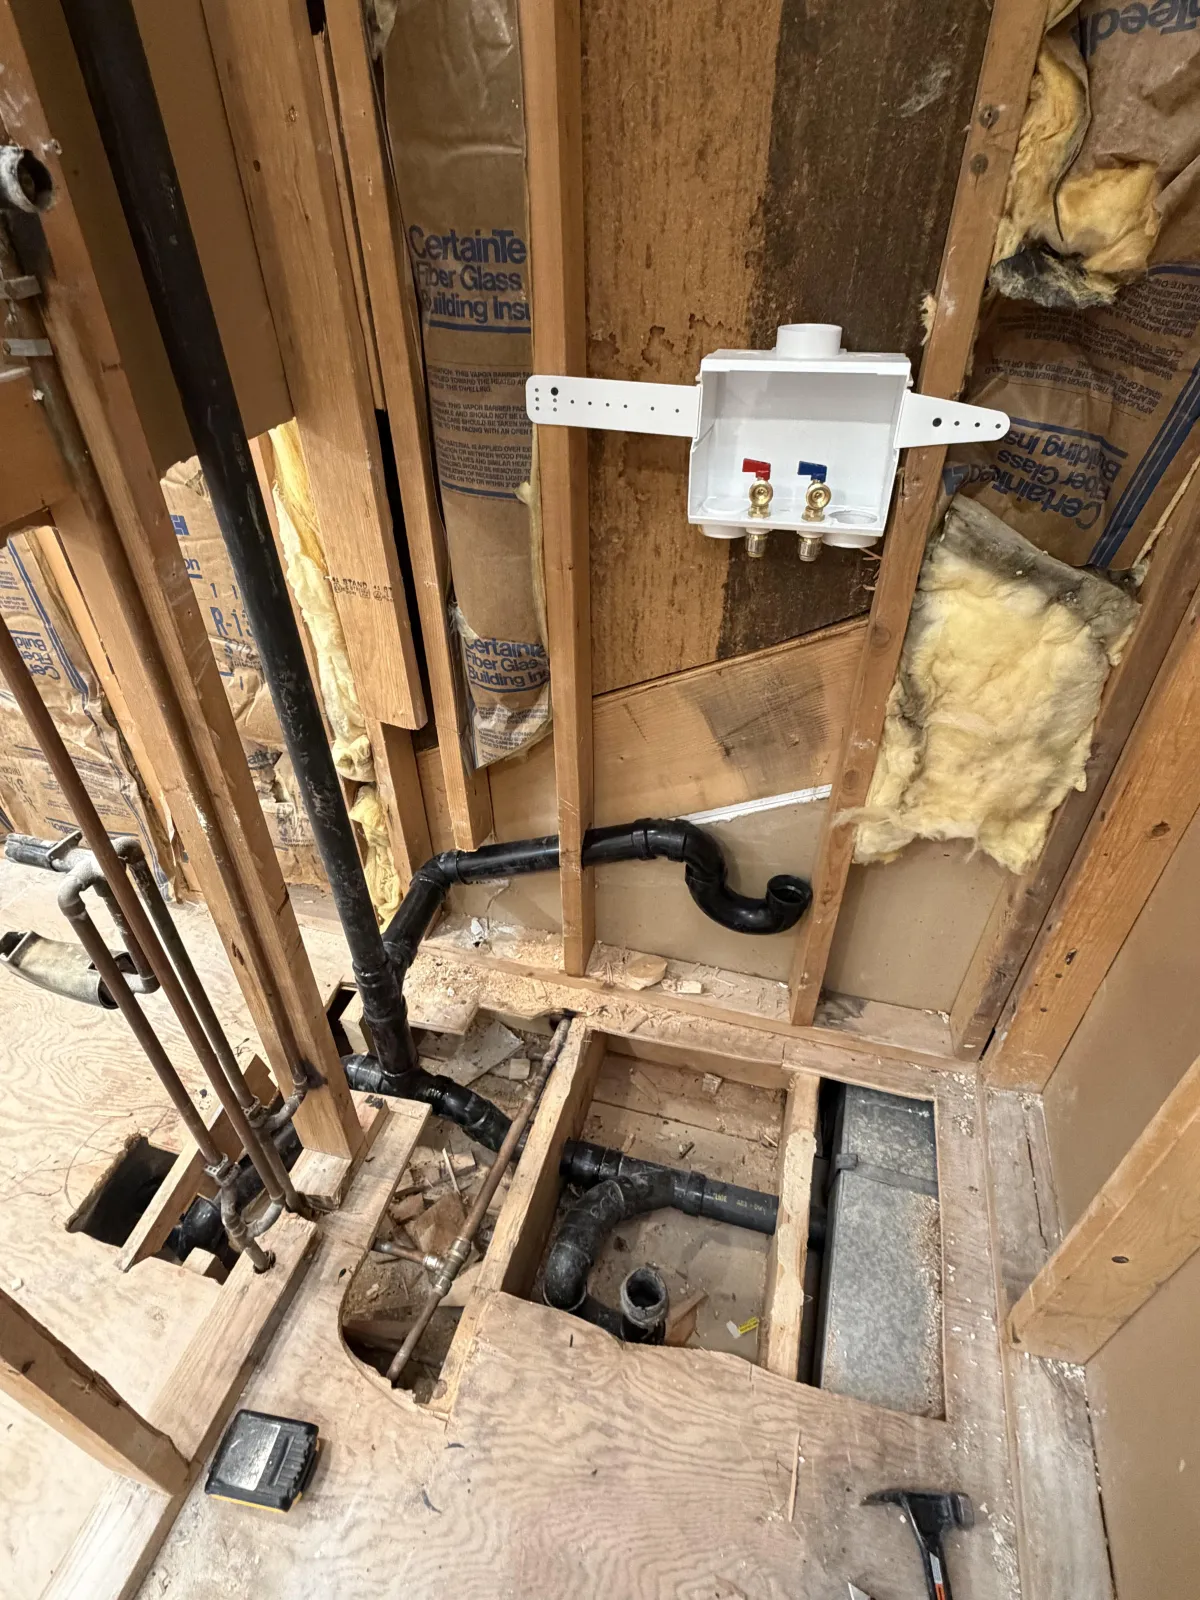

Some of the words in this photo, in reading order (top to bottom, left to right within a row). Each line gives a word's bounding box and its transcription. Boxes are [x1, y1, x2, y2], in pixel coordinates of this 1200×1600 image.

[416, 260, 457, 290] Fiber
[460, 264, 523, 292] Glass
[997, 450, 1060, 486] Glass
[466, 649, 498, 671] Fiber
[468, 664, 526, 688] Building
